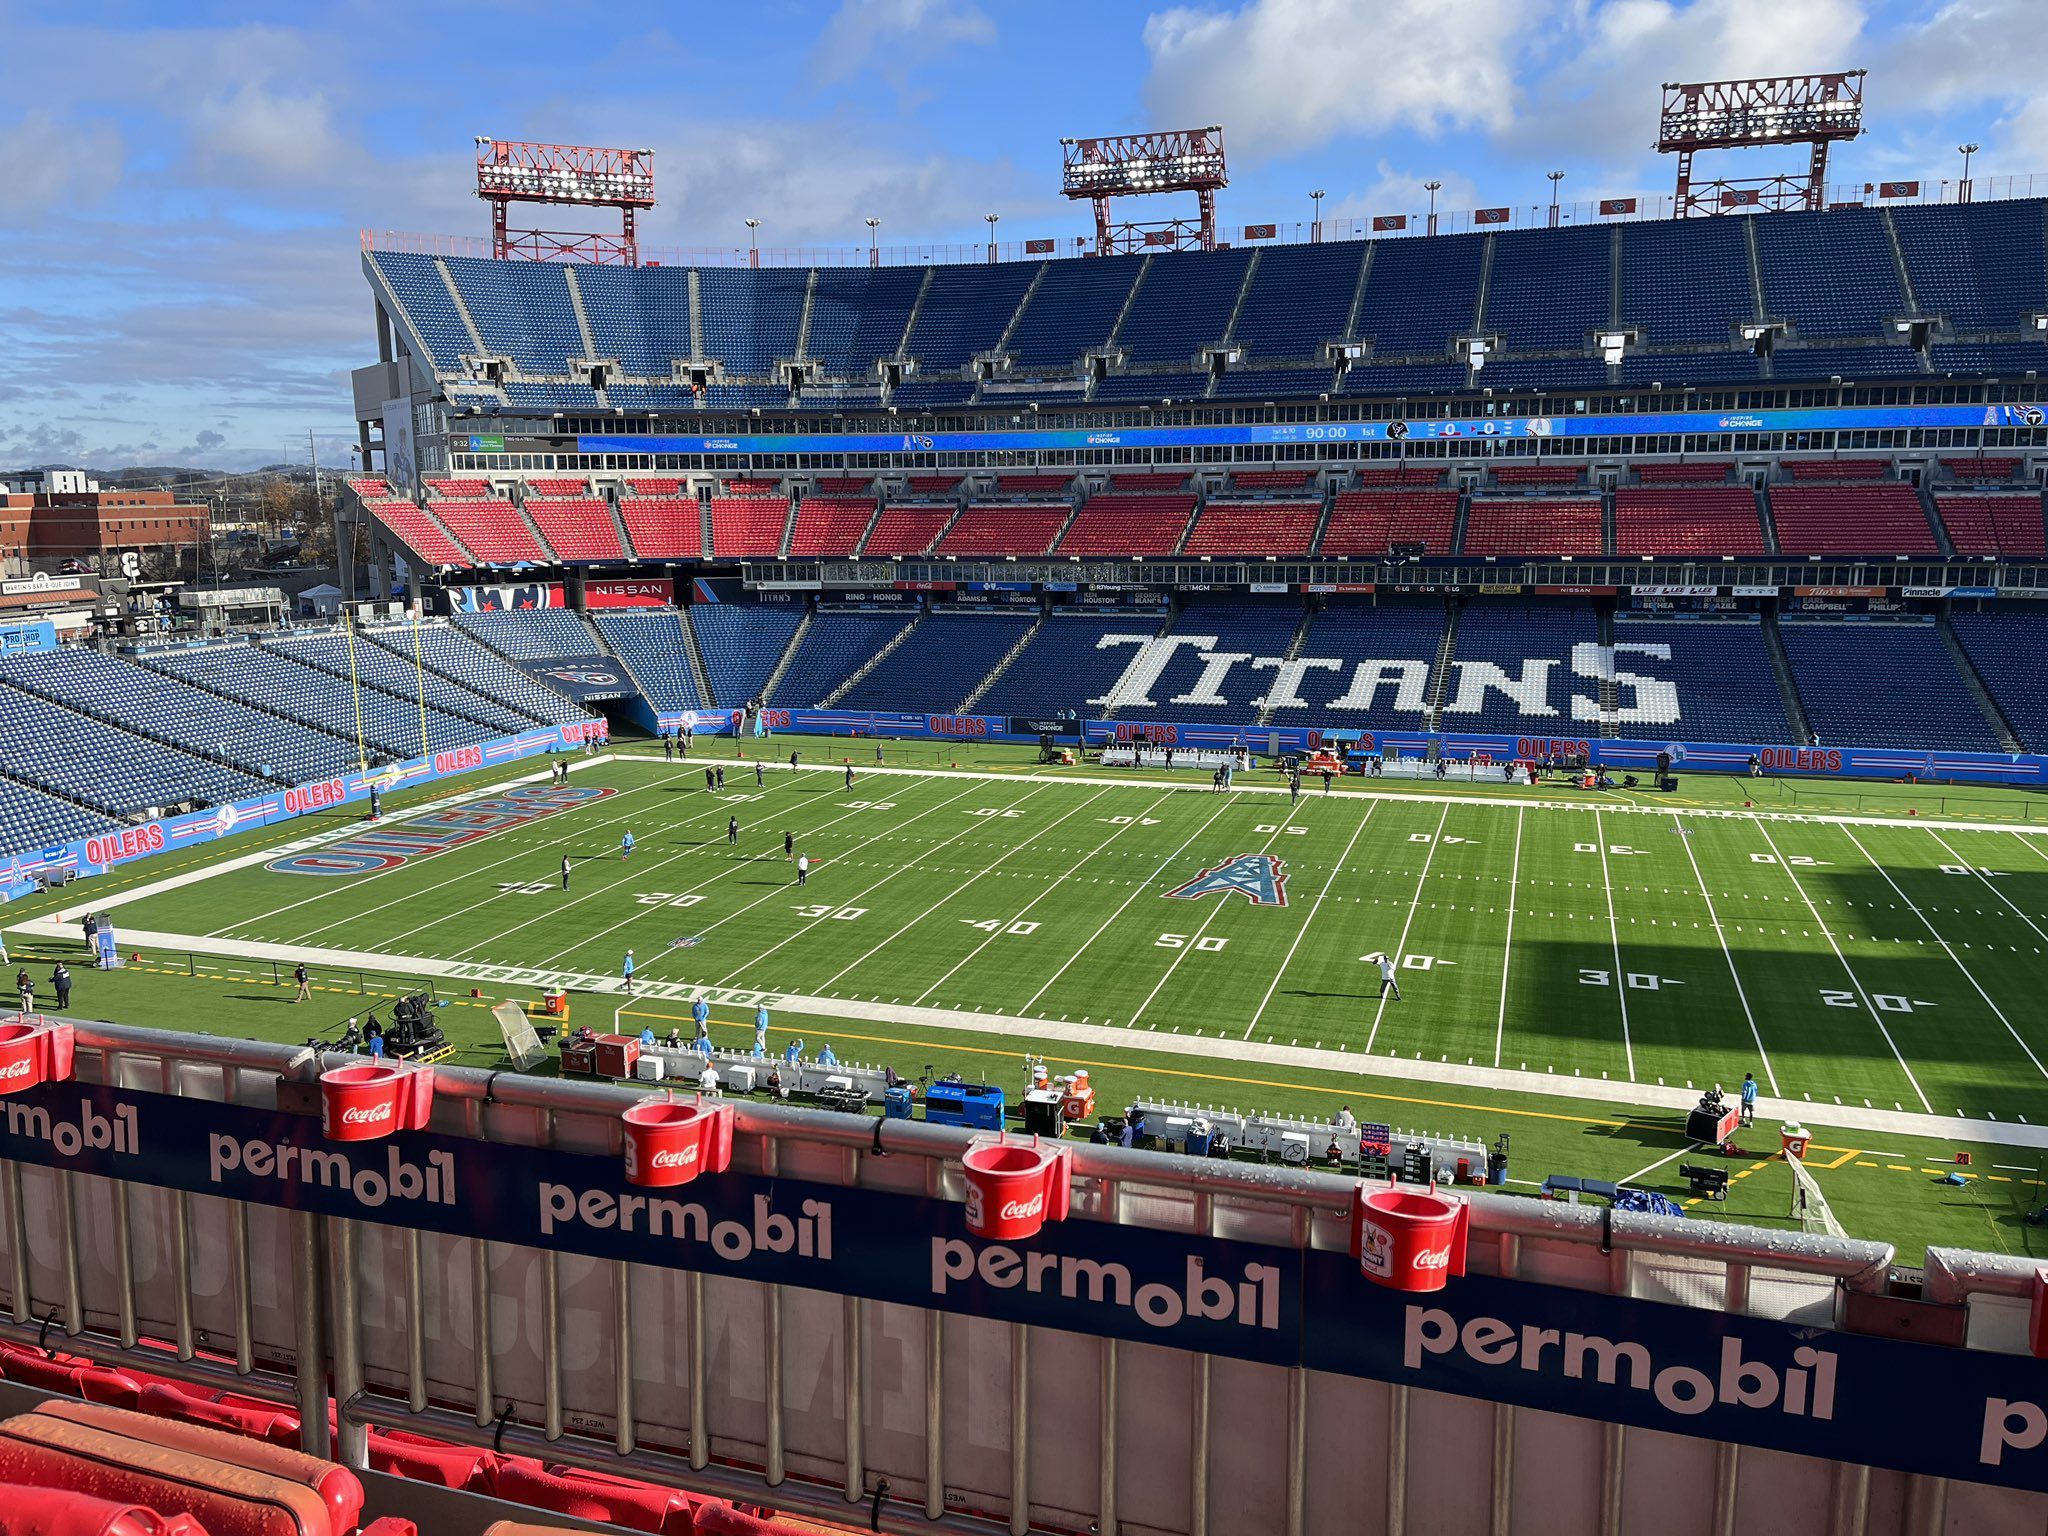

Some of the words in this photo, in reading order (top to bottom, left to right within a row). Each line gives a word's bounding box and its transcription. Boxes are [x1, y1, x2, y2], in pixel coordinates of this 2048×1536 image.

[1306, 426, 1347, 439] 90:00
[1362, 428, 1376, 438] 1st
[1445, 423, 1456, 436] 0
[1484, 422, 1494, 435] 0
[596, 584, 663, 596] NISSAN
[759, 591, 791, 602] TITANS
[845, 593, 866, 601] RING
[873, 593, 903, 601] HONOR
[1179, 584, 1210, 592] BETMGM
[1809, 586, 1835, 597] Tito's
[1903, 587, 1941, 597] Pinnacle
[1802, 603, 1847, 611] CAMPBELL
[5, 634, 20, 643] PRO
[1086, 630, 1681, 725] TITANS
[584, 692, 622, 702] NISSAN
[731, 709, 791, 728] OERS
[929, 714, 987, 736] OILERS
[561, 719, 609, 743] OILERS
[1516, 736, 1591, 760] OILERS
[435, 745, 483, 775] OILERS
[1760, 747, 1843, 772] OILERS
[284, 778, 346, 814] OILERS
[264, 785, 620, 877] OILERS
[85, 823, 165, 865] OILERS
[637, 893, 707, 907] 20
[805, 904, 870, 921] 30
[973, 918, 1043, 936] 40
[1153, 932, 1230, 952] 50
[441, 963, 606, 990] INSPIRE
[617, 979, 786, 1008] CHANGE
[1578, 968, 1660, 992] 30
[547, 999, 556, 1008] G
[1818, 988, 1916, 1014] 20
[342, 1101, 393, 1124] Coca-Cola
[1066, 1100, 1080, 1115] G
[652, 1142, 699, 1168] Coca-Cola
[1789, 1140, 1802, 1152] G
[1957, 1153, 1969, 1165] 20
[209, 1132, 457, 1207] permobil
[538, 1181, 833, 1262] permobil
[930, 1236, 1280, 1331] permobil
[1403, 1304, 1839, 1421] permobil
[585, 1418, 605, 1429] WEST
